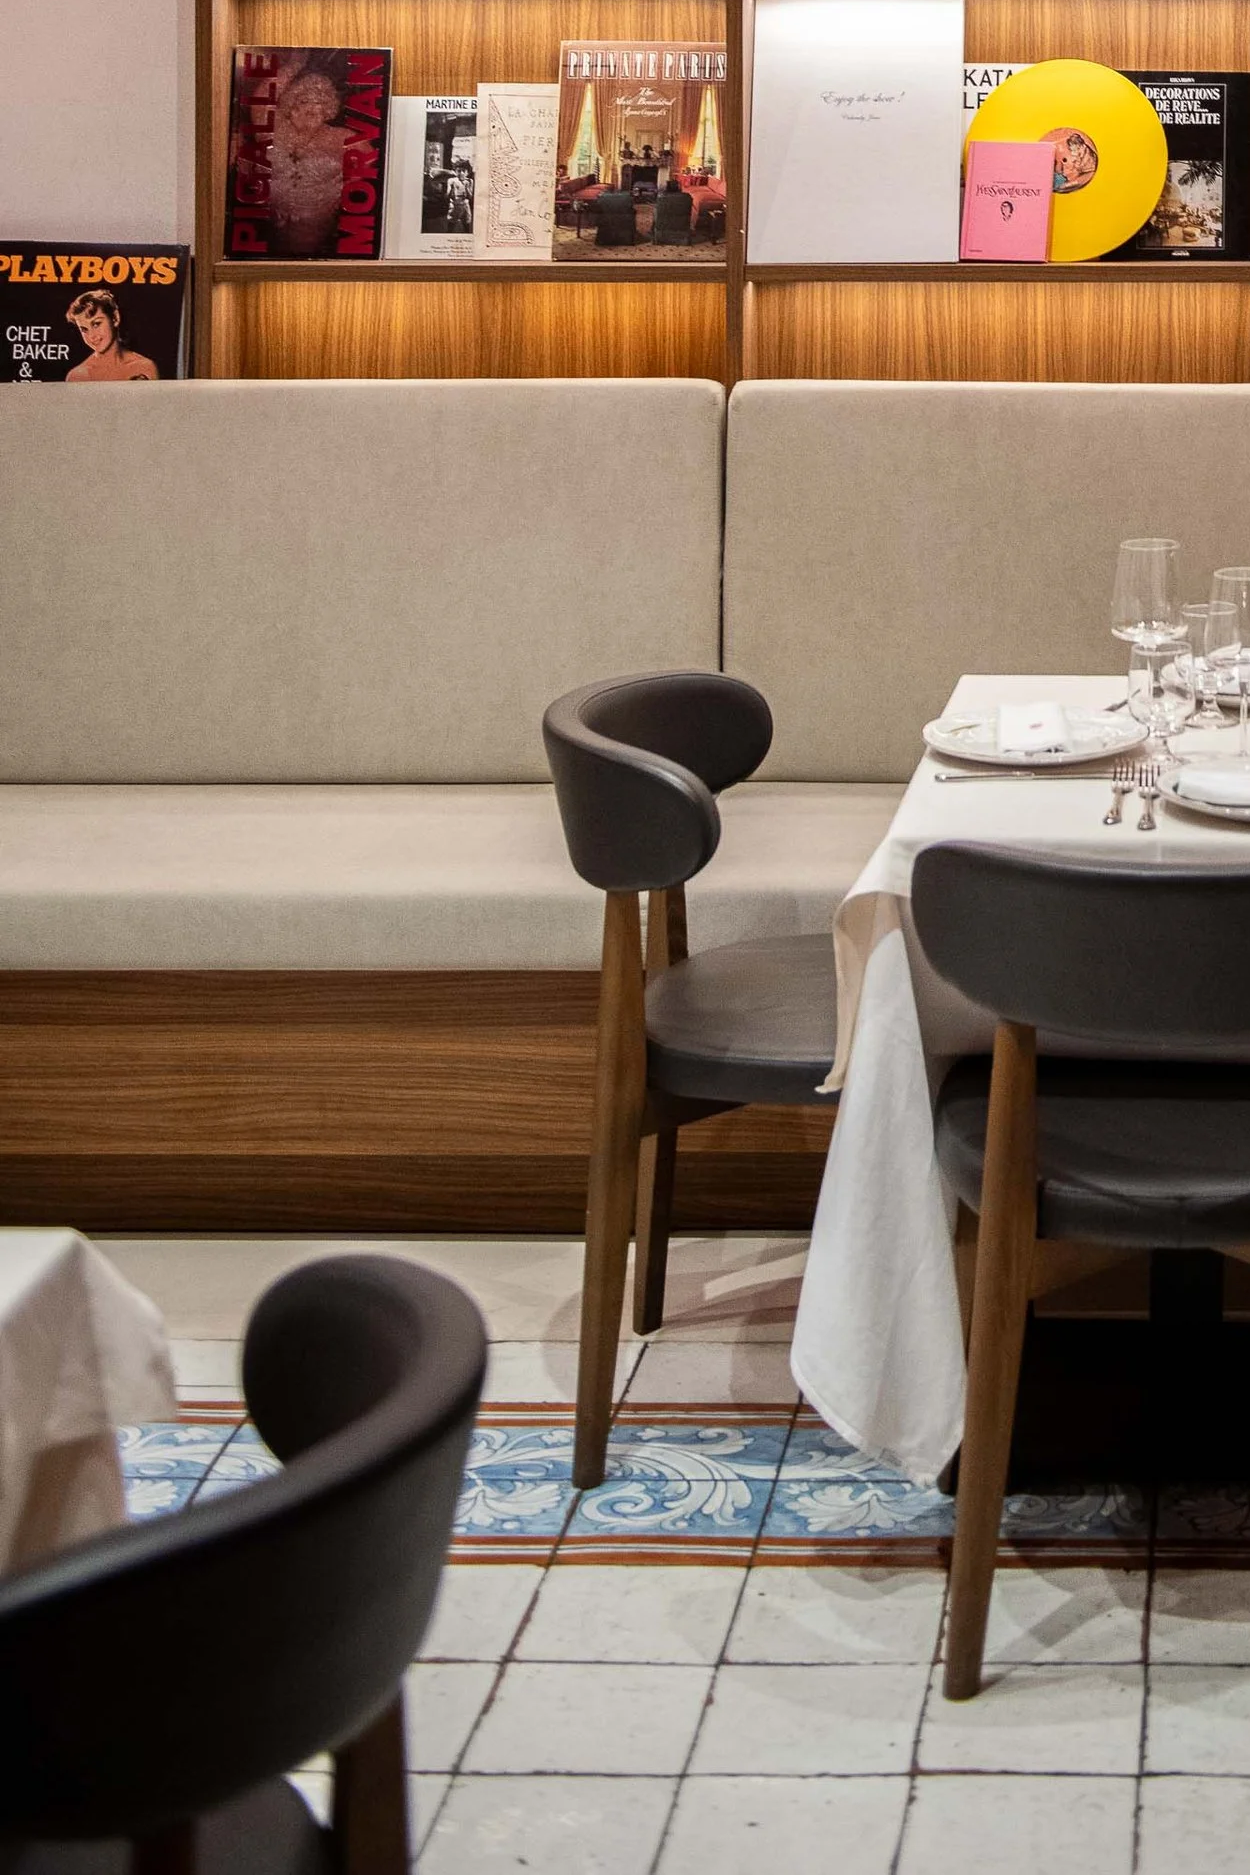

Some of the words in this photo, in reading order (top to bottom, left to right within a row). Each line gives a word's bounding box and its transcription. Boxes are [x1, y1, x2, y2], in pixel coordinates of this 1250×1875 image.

[568, 50, 658, 80] PRIVATE
[663, 51, 727, 81] PARIS
[820, 90, 855, 106] Enjoy
[856, 92, 871, 102] the
[1145, 87, 1220, 100] DECORATIONS
[425, 99, 467, 110] MARTINE
[1155, 100, 1171, 112] DE
[1159, 112, 1173, 124] DE
[1174, 112, 1221, 125] REALITE
[232, 53, 278, 252] PIGALLE
[337, 55, 385, 254] MORVAN
[0, 255, 178, 285] PLAYBOYS
[6, 325, 51, 342] CHET
[12, 344, 69, 360] BAKER
[19, 361, 33, 378] &
